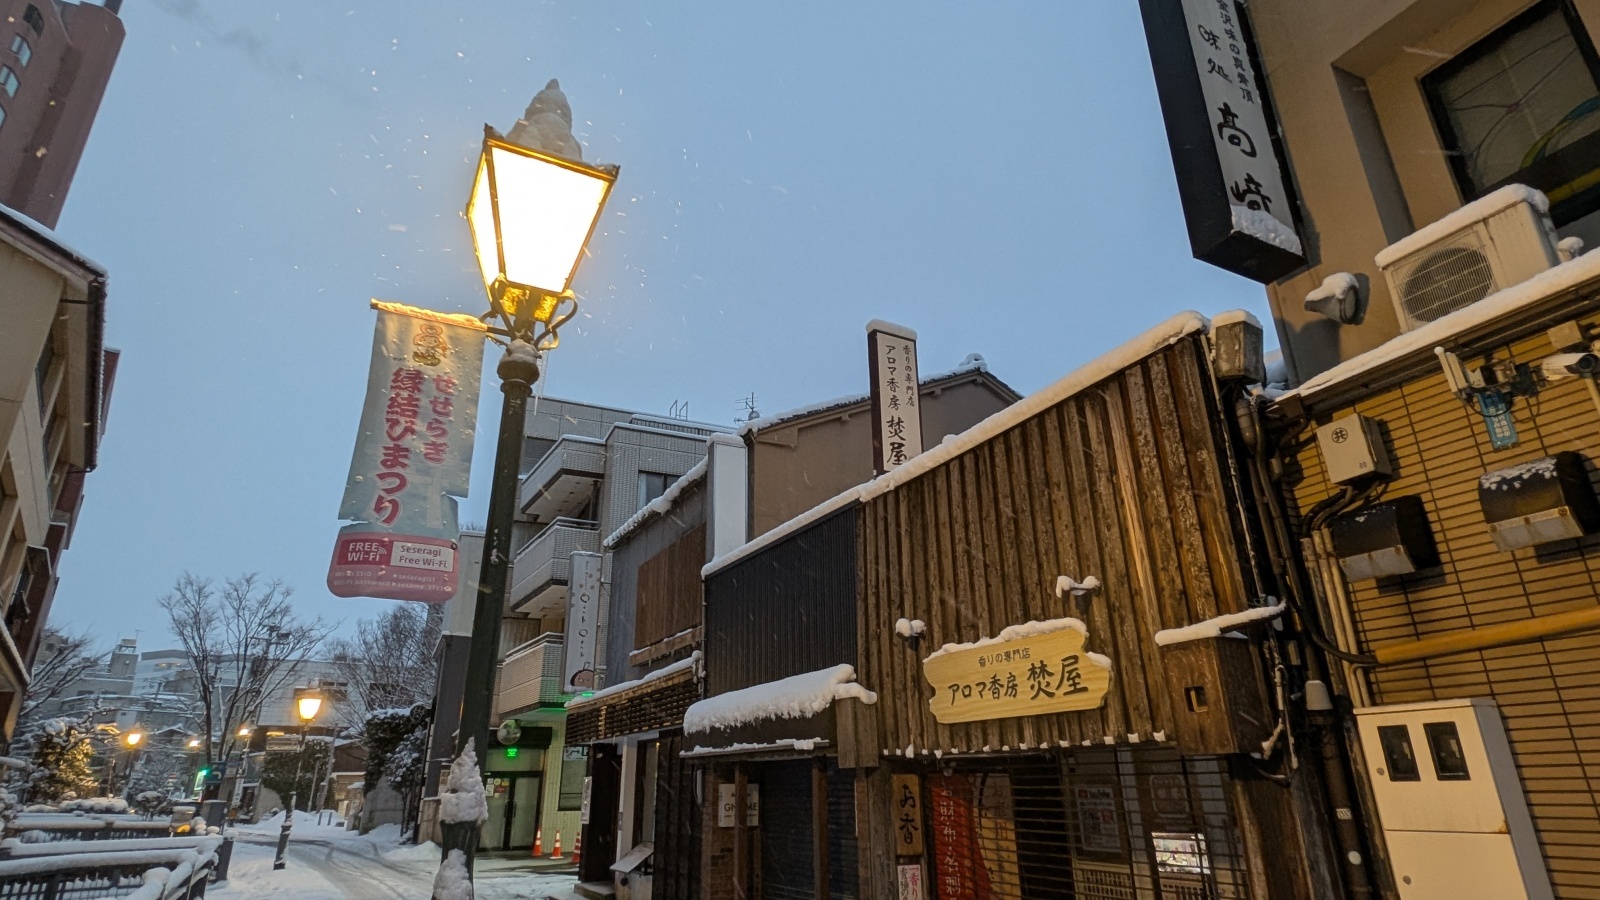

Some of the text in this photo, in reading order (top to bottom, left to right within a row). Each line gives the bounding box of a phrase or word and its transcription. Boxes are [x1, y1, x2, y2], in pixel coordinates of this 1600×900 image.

[902, 344, 915, 408] 香りの専門店
[422, 374, 457, 464] せせらぎ
[885, 344, 908, 466] アロマ香房 焚屋
[373, 366, 424, 525] 縁結びまつり
[347, 552, 380, 562] Wi-Fi
[349, 542, 379, 552] FREE
[399, 556, 448, 568] Free Wi-Fi
[400, 545, 442, 557] Seseragi
[947, 654, 1089, 705] アロマ香房 焚屋
[977, 647, 1031, 668] 香りの専門店
[898, 783, 919, 845] お香
